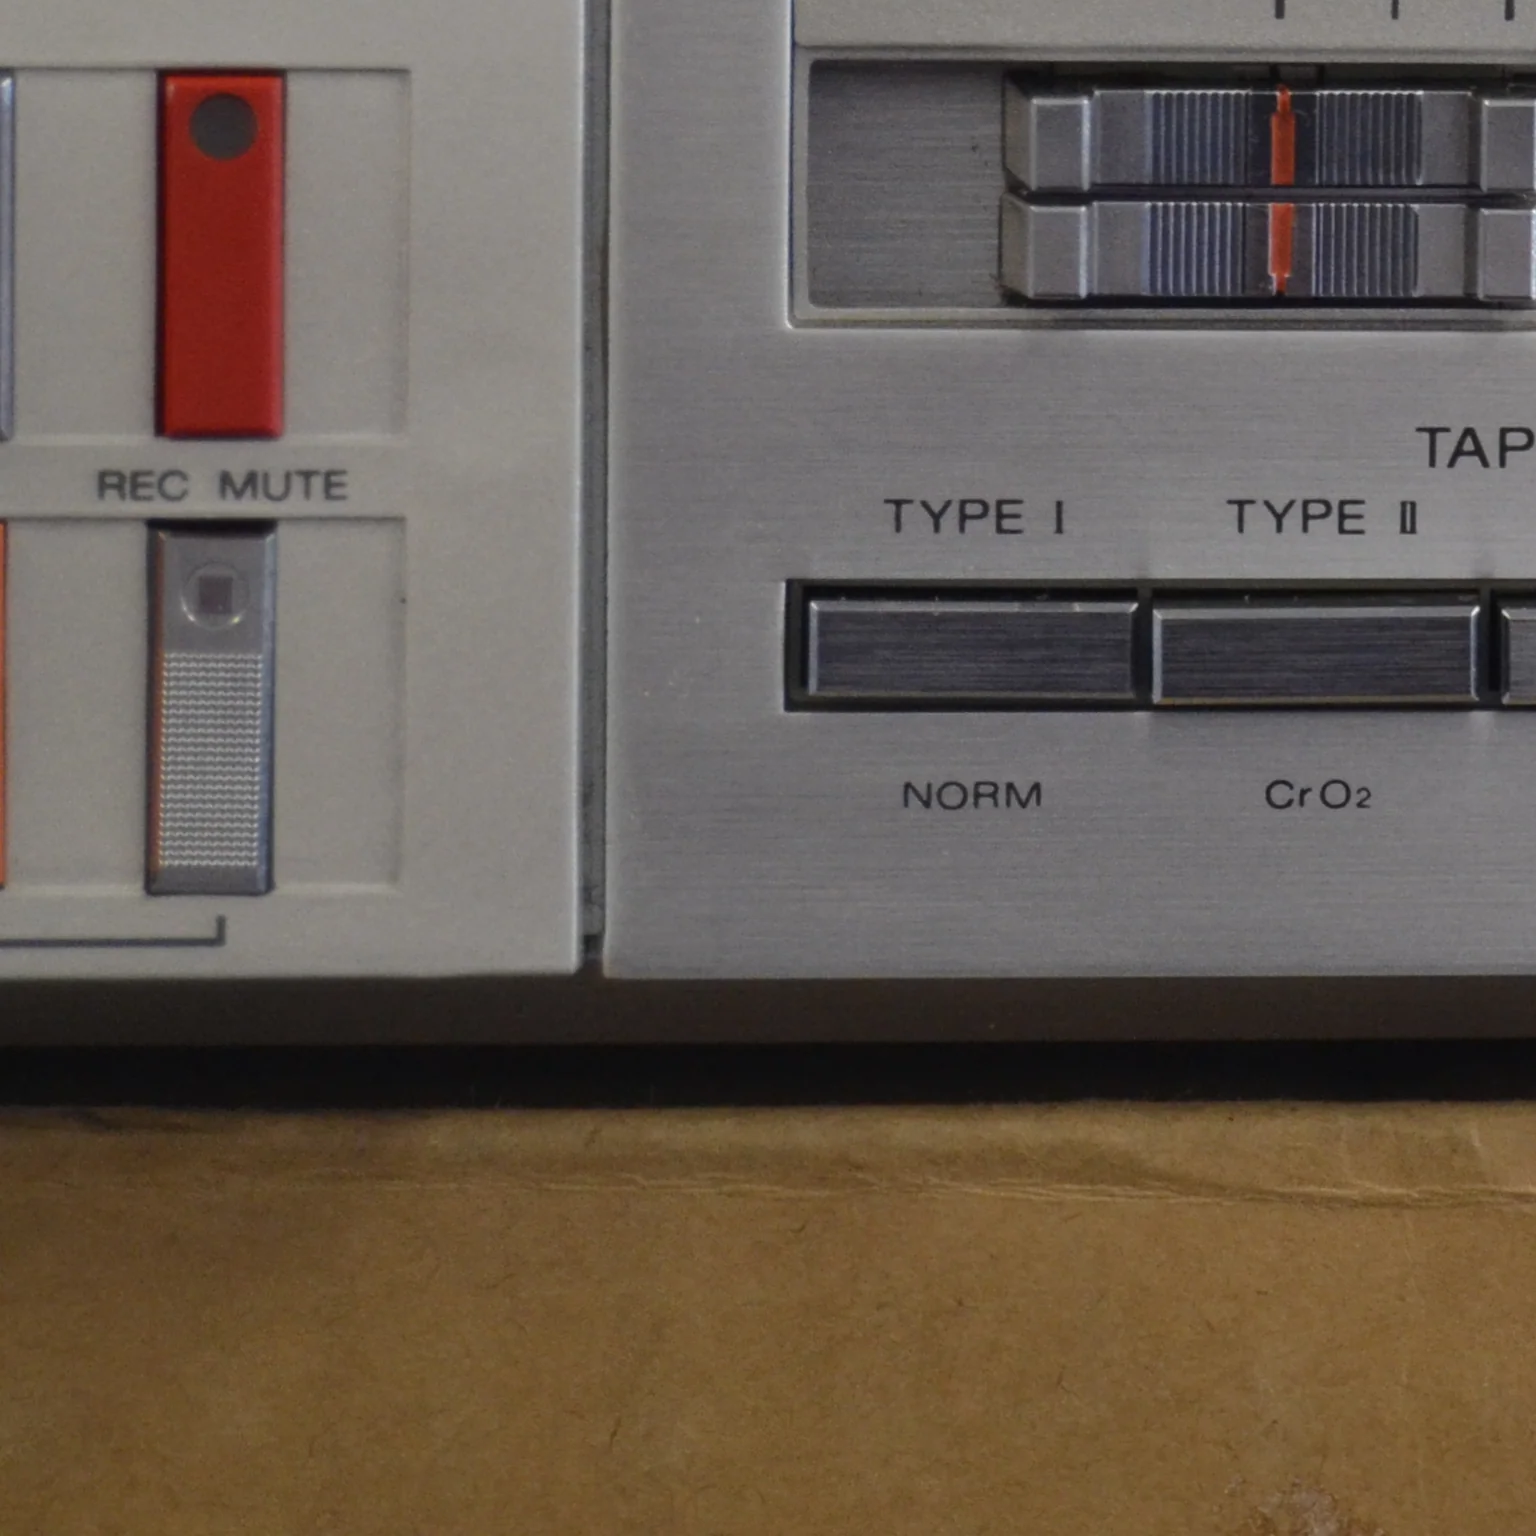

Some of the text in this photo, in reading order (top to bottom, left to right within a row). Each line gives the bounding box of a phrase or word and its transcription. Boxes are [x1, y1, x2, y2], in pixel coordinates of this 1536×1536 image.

[96, 468, 347, 502] REC MUTE
[883, 498, 1024, 535] TYPE
[1226, 498, 1366, 535] TYPE
[902, 780, 1042, 811] NORM
